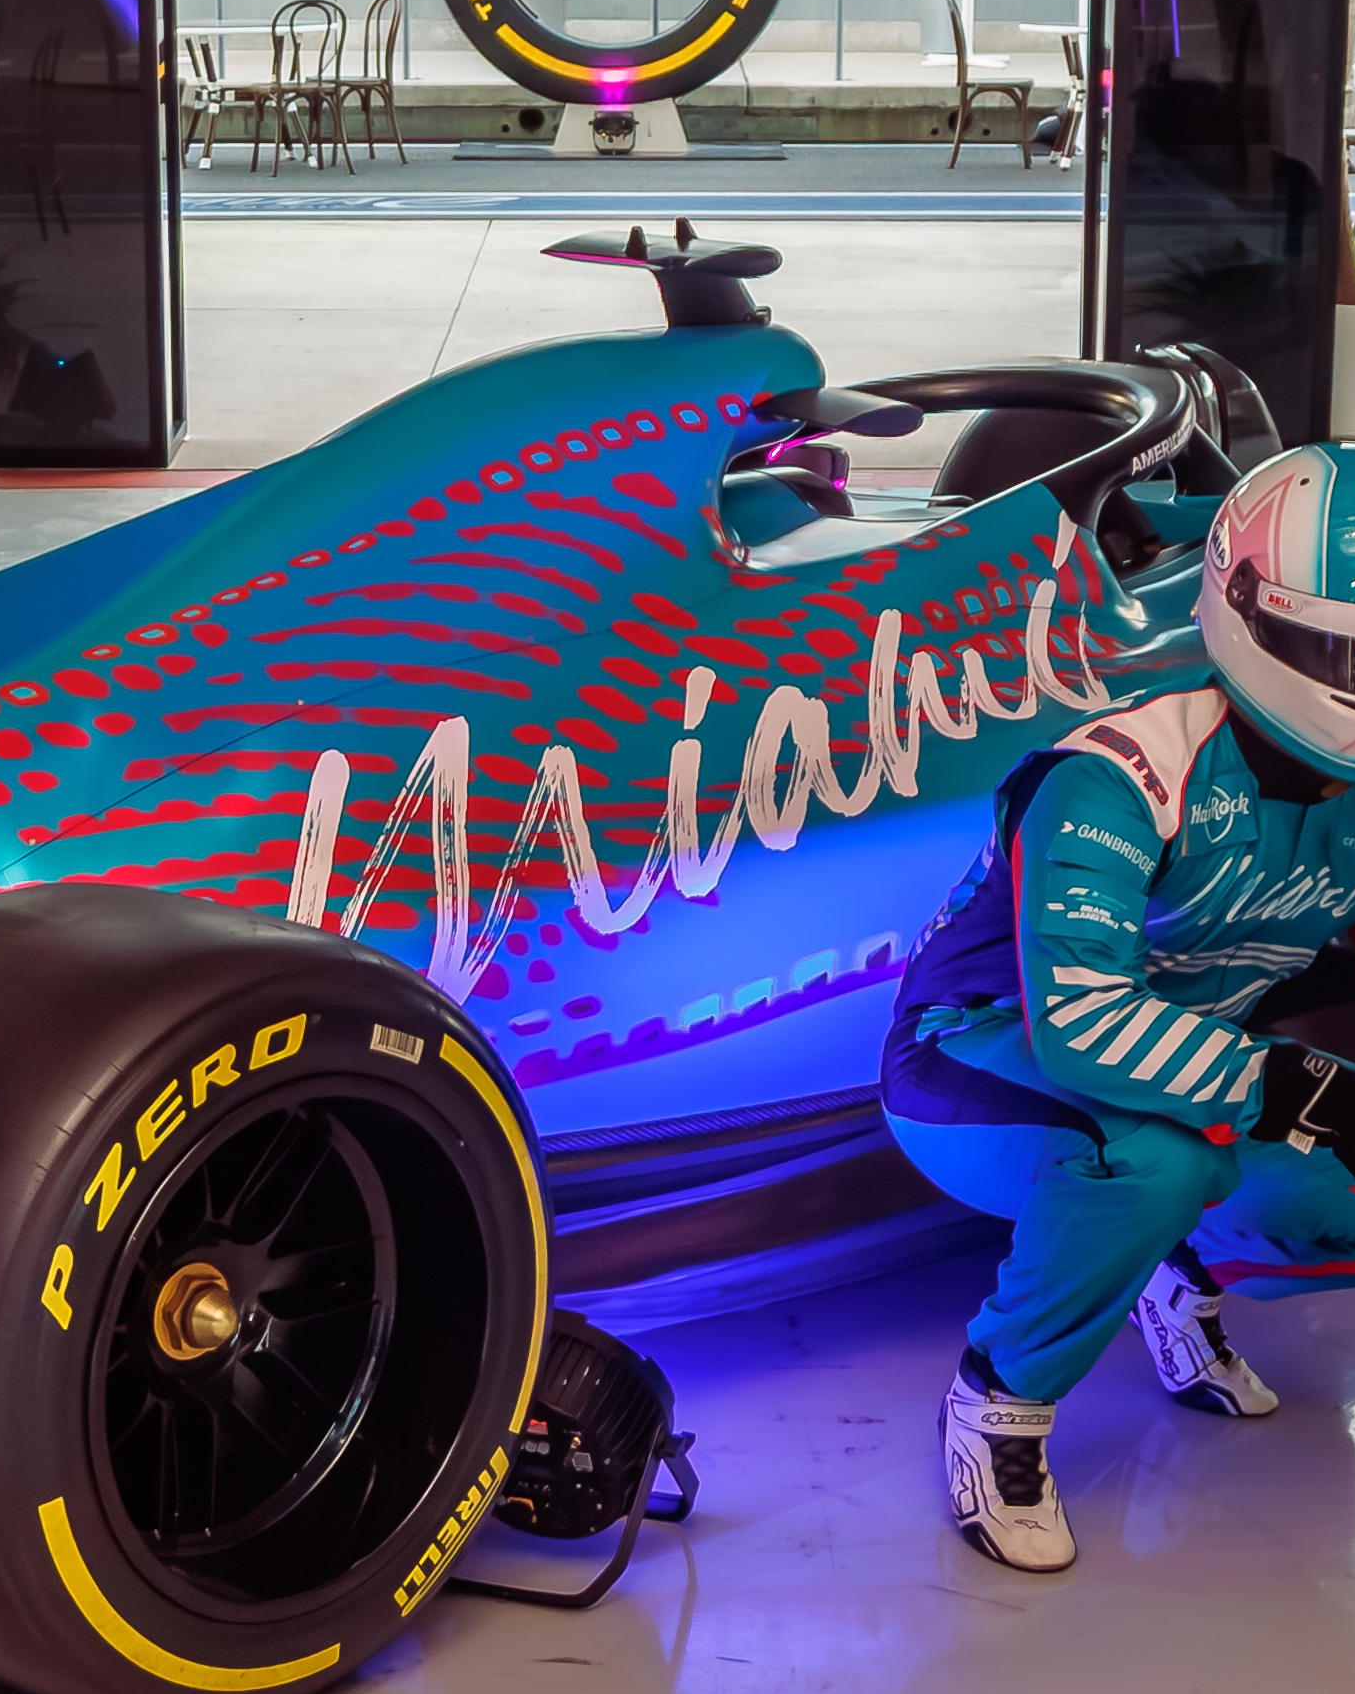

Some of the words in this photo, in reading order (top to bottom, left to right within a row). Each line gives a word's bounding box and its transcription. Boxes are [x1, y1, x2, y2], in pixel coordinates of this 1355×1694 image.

[1268, 594, 1293, 610] BELL
[287, 510, 1112, 1007] Miami
[1210, 790, 1250, 821] Rock
[1077, 823, 1157, 876] GAINBRIDGE
[41, 1244, 74, 1330] P
[84, 1013, 307, 1232] ZERO
[394, 1445, 510, 1617] PIRELLI
